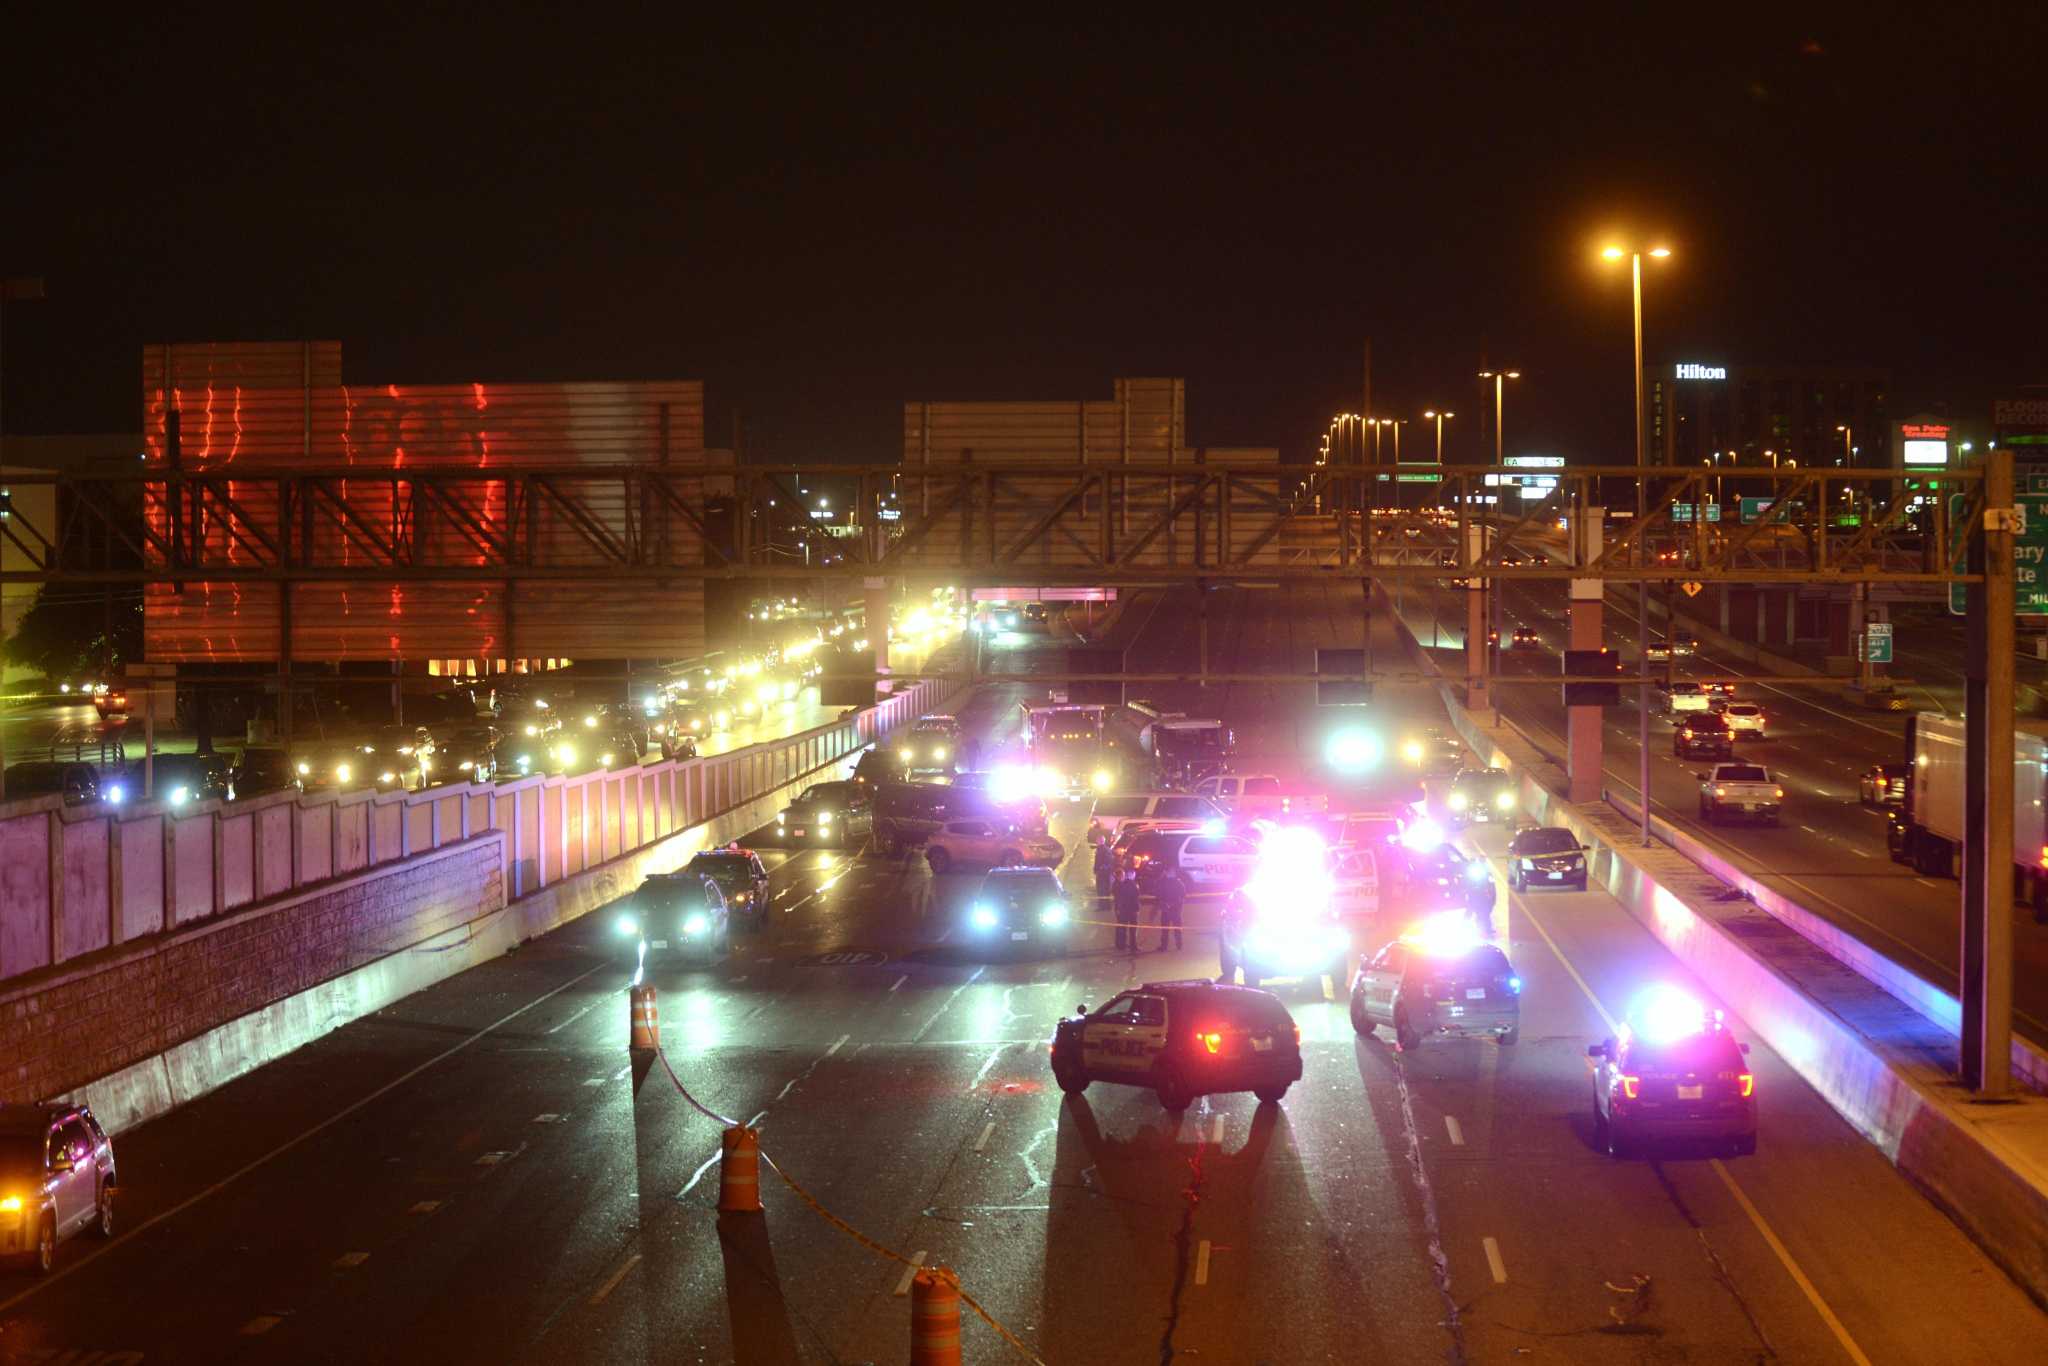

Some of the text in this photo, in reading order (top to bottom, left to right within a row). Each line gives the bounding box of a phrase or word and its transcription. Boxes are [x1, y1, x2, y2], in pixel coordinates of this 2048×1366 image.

[1676, 364, 1726, 379] Hilton
[2014, 546, 2044, 563] ary
[2017, 567, 2036, 583] le
[2029, 593, 2048, 604] MIL
